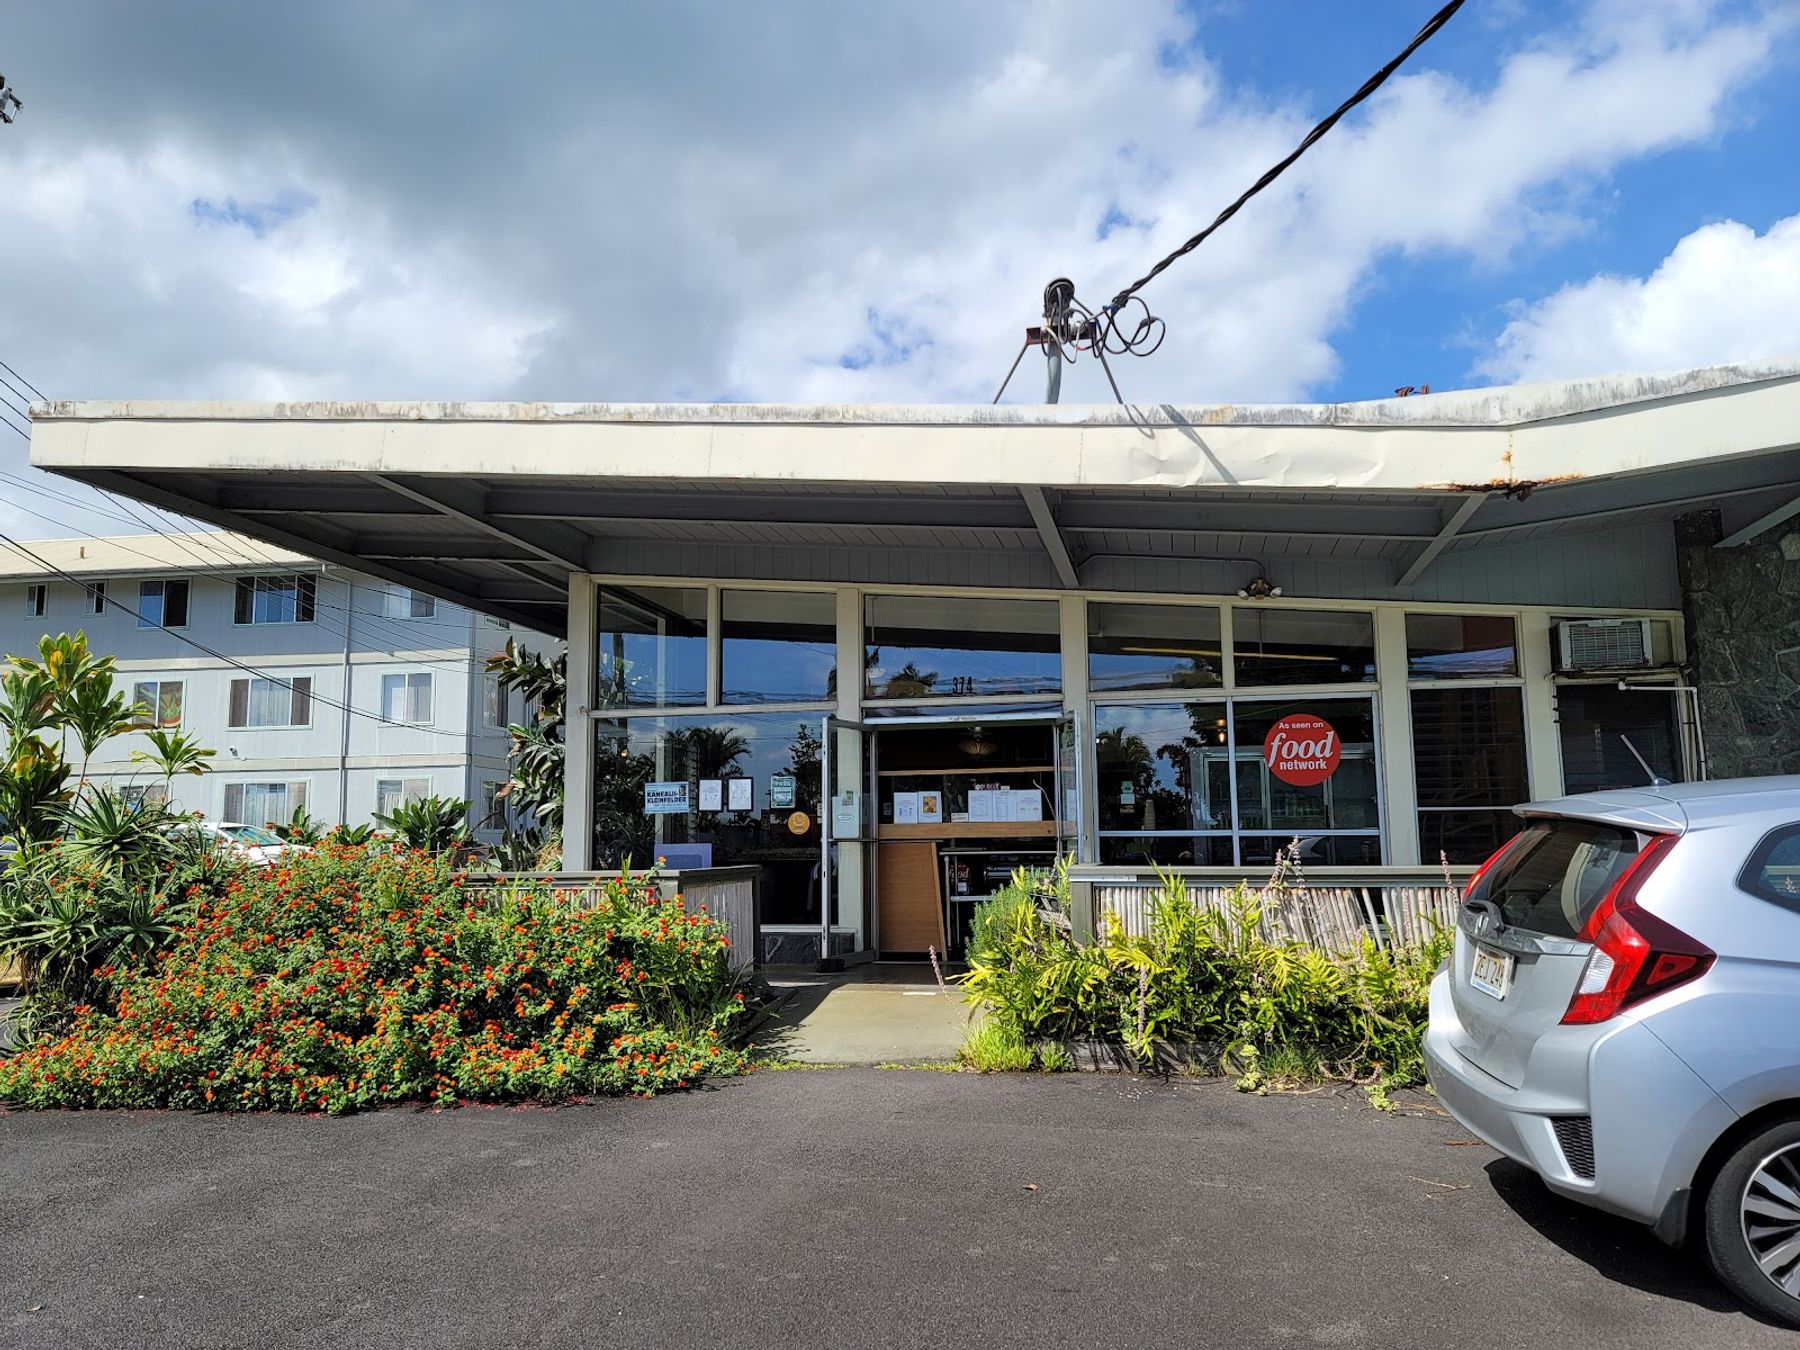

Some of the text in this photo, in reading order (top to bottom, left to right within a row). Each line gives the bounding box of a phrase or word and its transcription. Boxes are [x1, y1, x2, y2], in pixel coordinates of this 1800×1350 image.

[952, 676, 973, 694] 374
[1268, 731, 1335, 768] food
[1279, 759, 1328, 771] network
